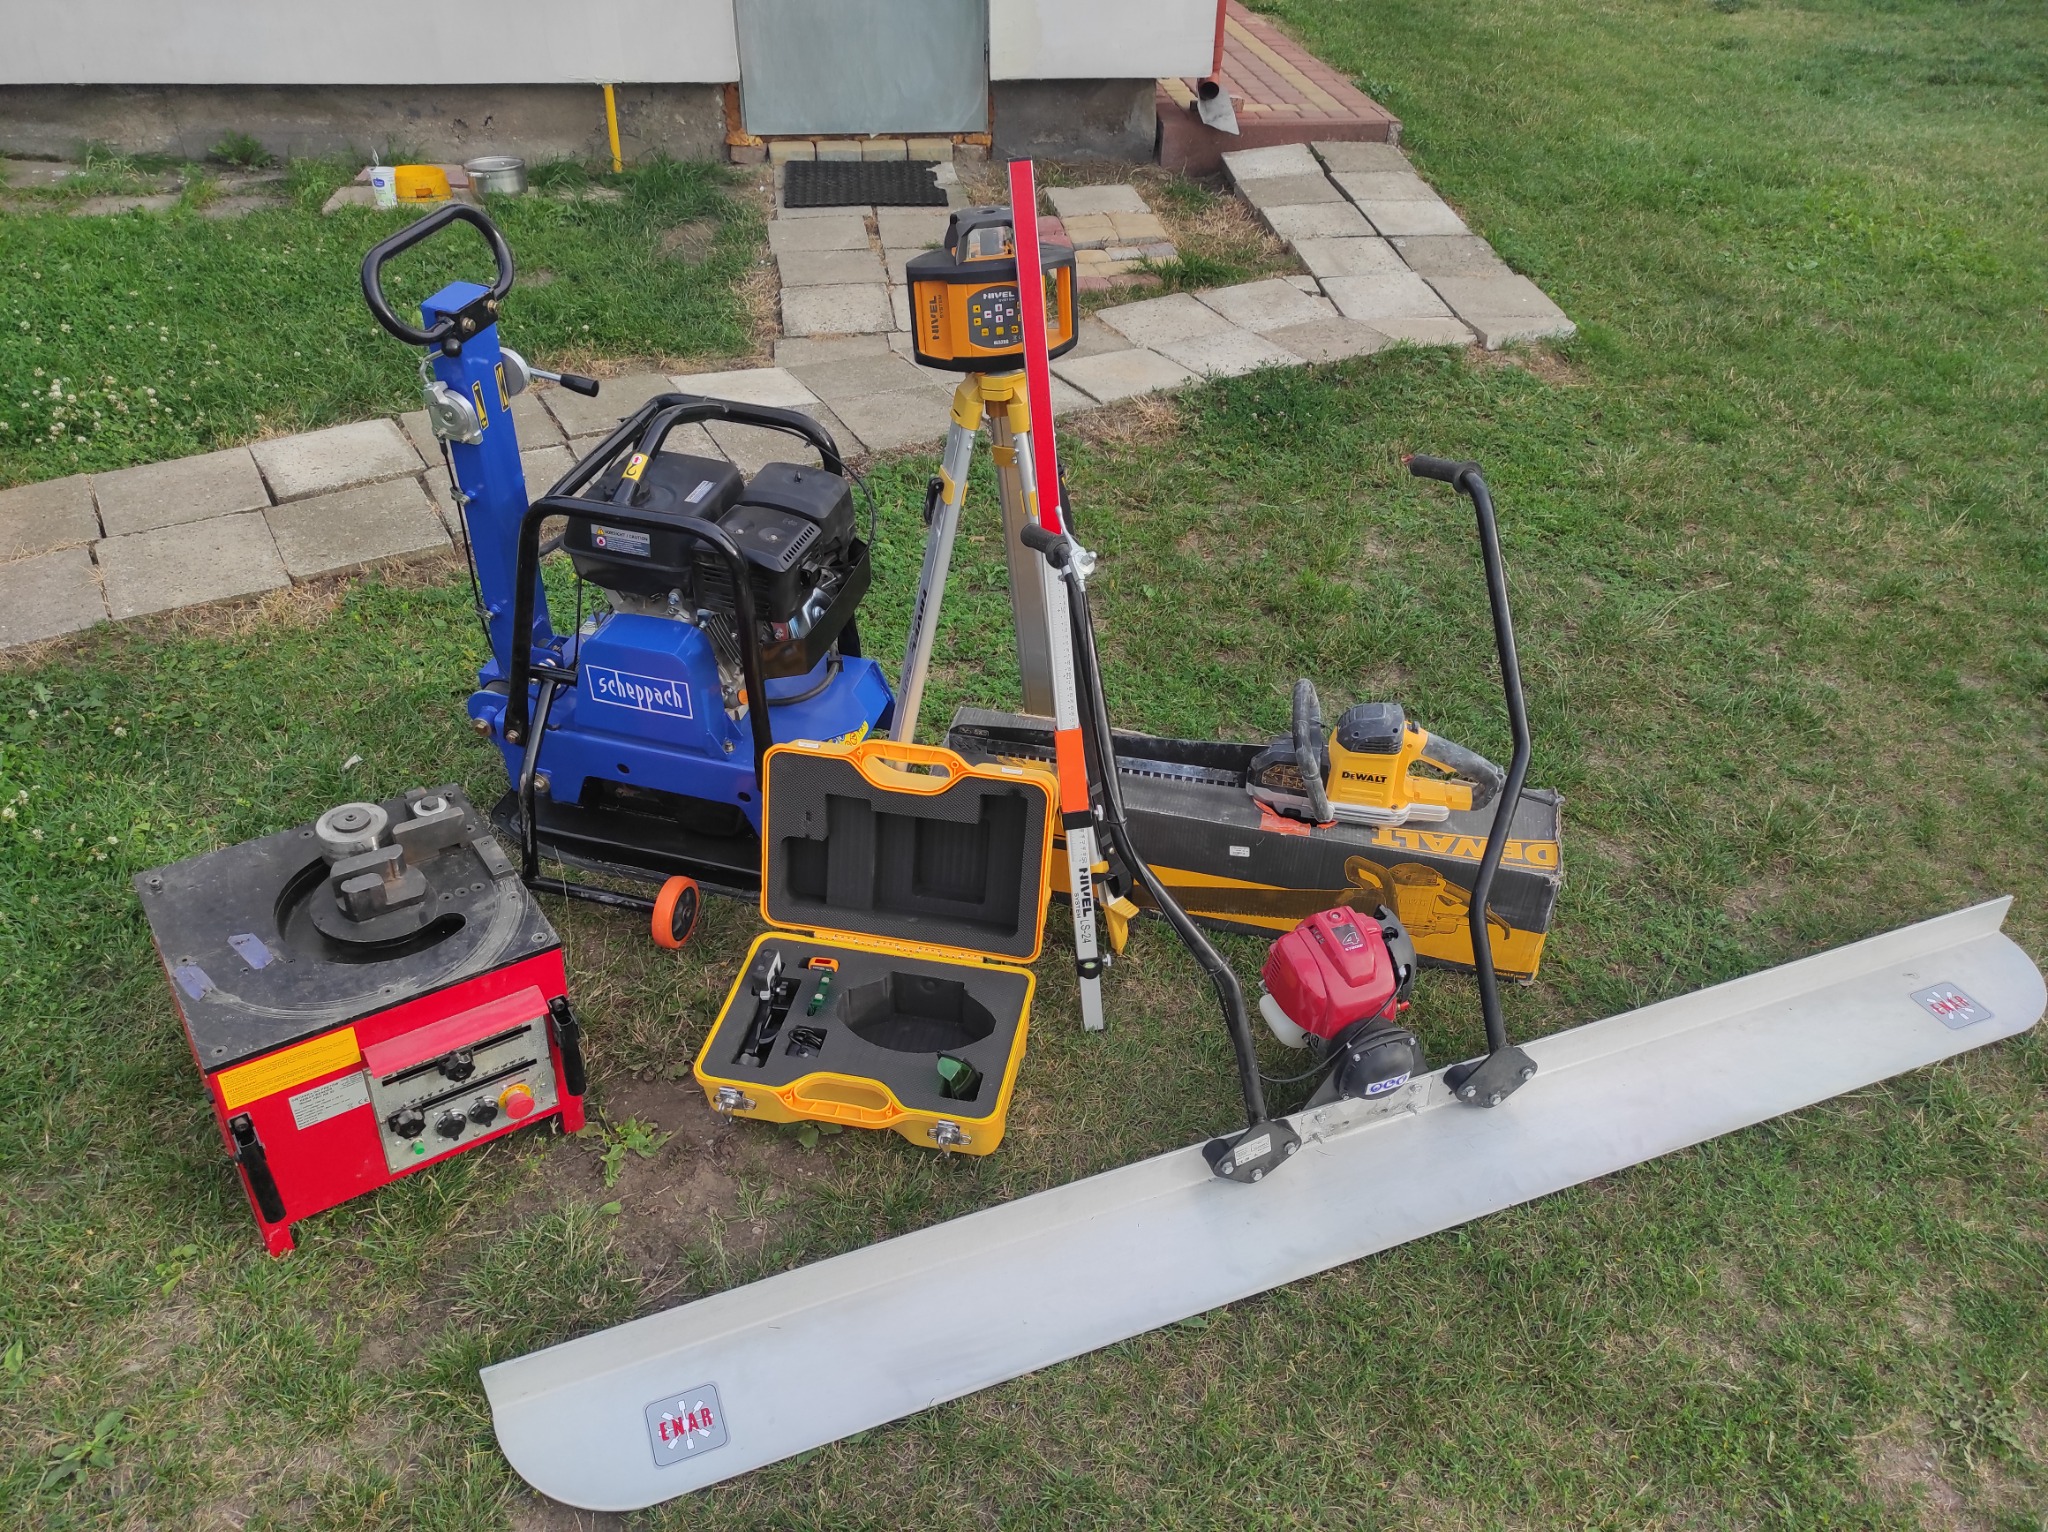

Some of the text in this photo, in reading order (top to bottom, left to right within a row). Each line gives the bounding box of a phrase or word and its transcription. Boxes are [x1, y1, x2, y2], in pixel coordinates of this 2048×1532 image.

[982, 290, 1015, 300] NIVEL
[929, 295, 940, 341] NIVEL
[598, 671, 684, 711] scheppach
[1073, 893, 1081, 919] SYSTEM
[1078, 867, 1093, 918] NIVEL
[1080, 920, 1092, 944] LS-24
[1930, 995, 1970, 1015] ENAR
[658, 1407, 713, 1442] ENAR
